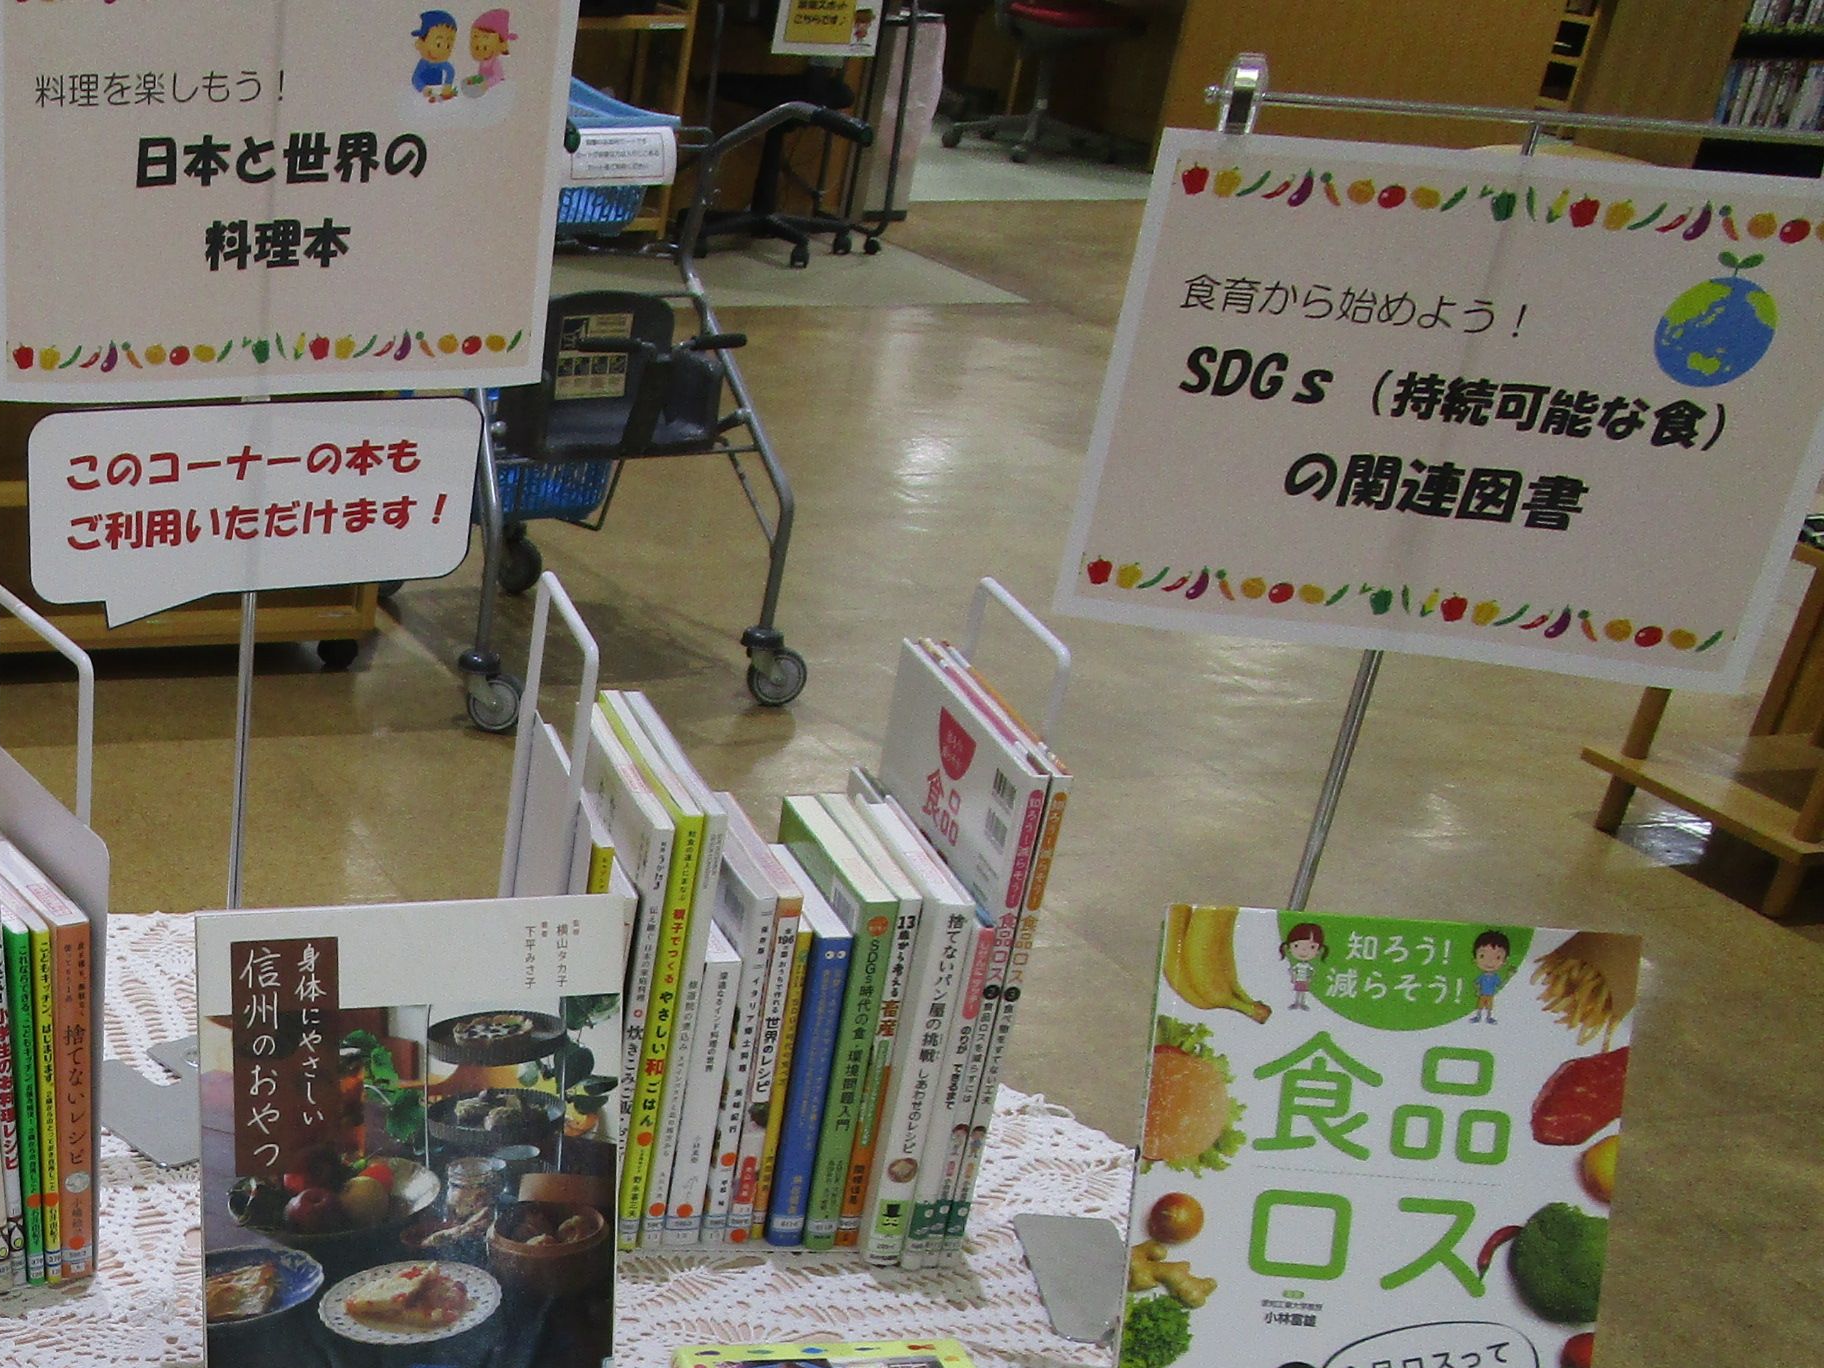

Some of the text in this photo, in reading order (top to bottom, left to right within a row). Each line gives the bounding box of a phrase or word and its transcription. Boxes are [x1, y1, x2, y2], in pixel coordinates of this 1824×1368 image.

[35, 69, 287, 109] 料理を楽しもう！
[135, 131, 429, 188] 日本と世界の
[204, 217, 351, 272] 料理本
[1179, 273, 1529, 338] 食育から始めよう！
[1179, 345, 1334, 406] SDGs
[66, 439, 422, 491] このコーナーの本も
[1283, 452, 1592, 532] の関連図書
[67, 493, 449, 551] ご利用いただけます！
[524, 926, 537, 989] 下平みさ子
[990, 912, 1019, 981] 食品ロス
[1006, 916, 1039, 983] 食品ロス
[1344, 929, 1453, 966] 知ろう！
[640, 908, 686, 1127] 親子でつくる やさしい和ごはん
[919, 912, 969, 1063] 捨てないパン屋の挑戦
[1325, 965, 1469, 1005] 減らそう！
[238, 946, 282, 1169] 信州のおやつ
[293, 943, 327, 1126] 身体にやさしい
[755, 1016, 780, 1093] 世界のレシピ
[62, 1024, 86, 1166] 捨てないレシピ
[1252, 1030, 1512, 1166] 食品
[1247, 1189, 1487, 1299] ロス
